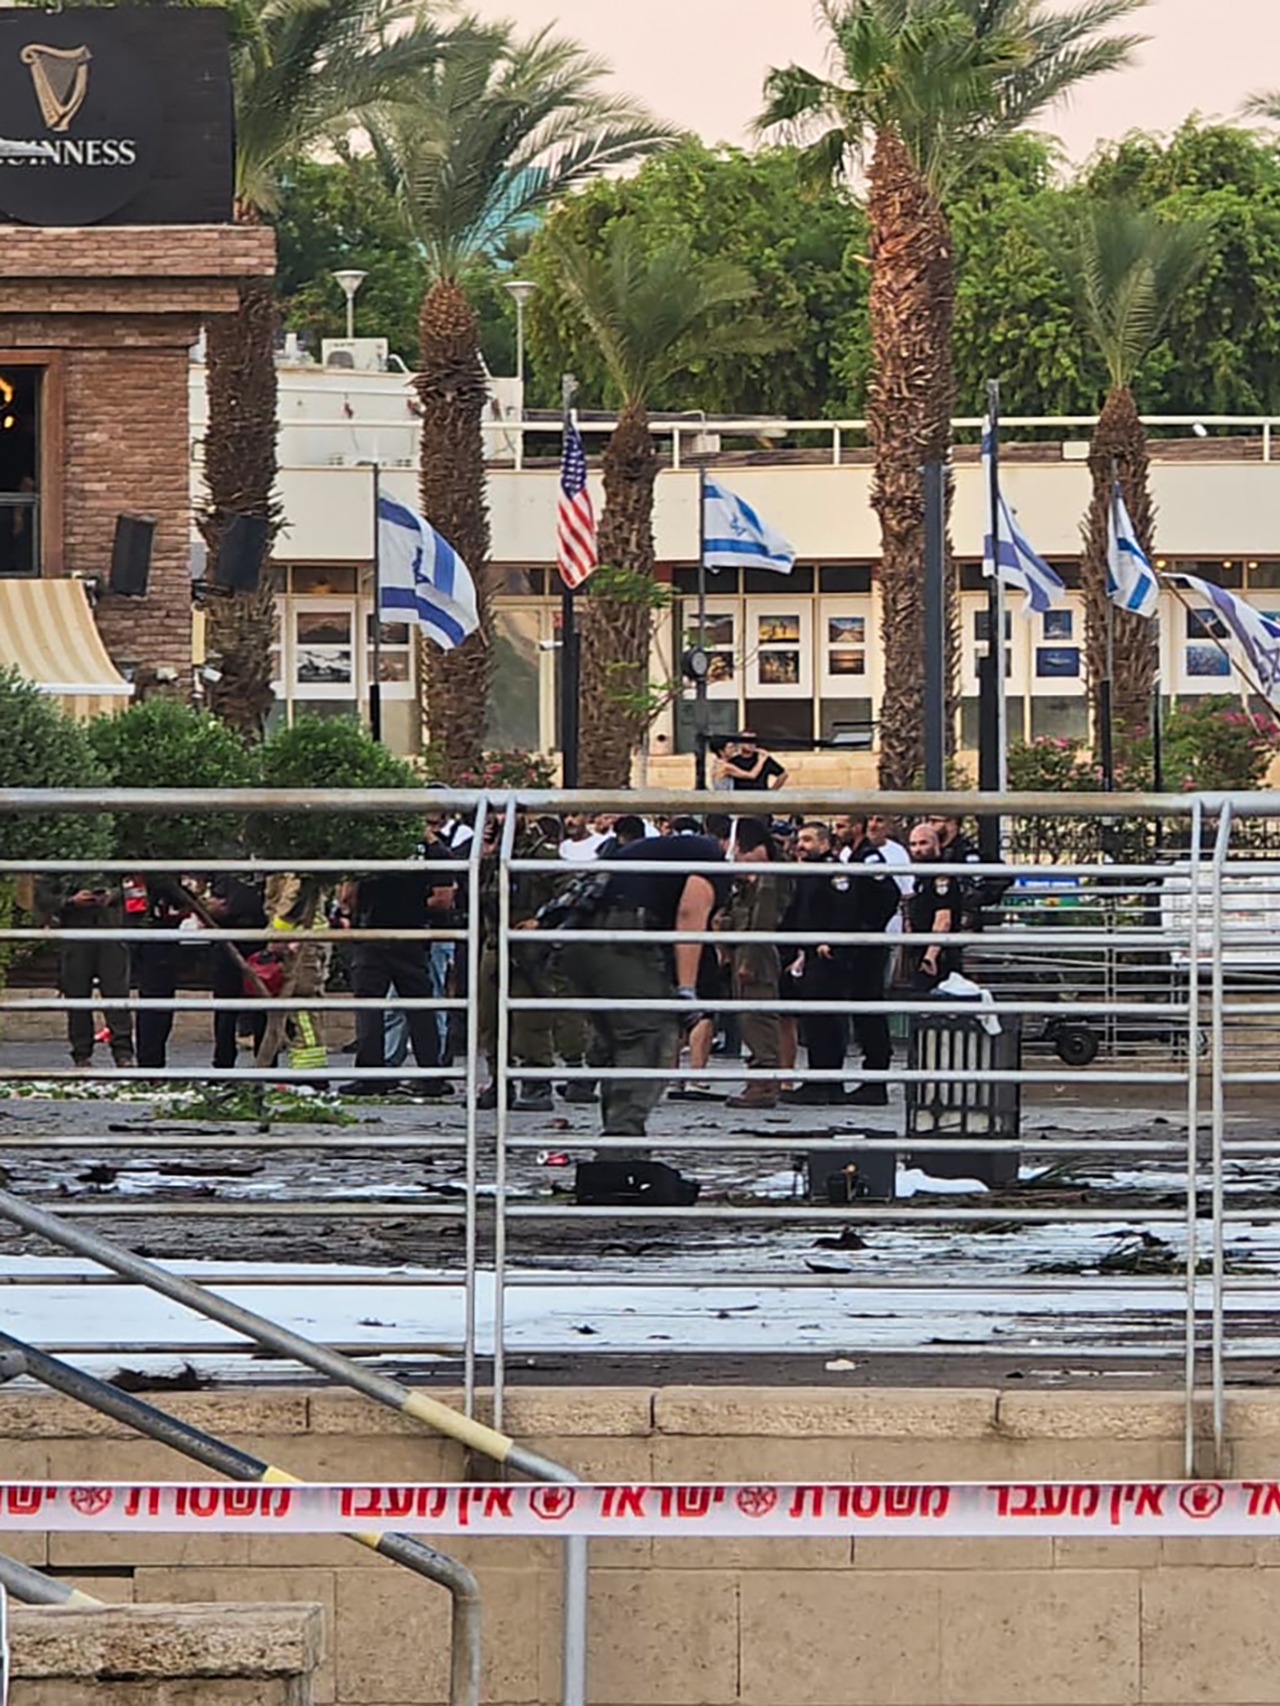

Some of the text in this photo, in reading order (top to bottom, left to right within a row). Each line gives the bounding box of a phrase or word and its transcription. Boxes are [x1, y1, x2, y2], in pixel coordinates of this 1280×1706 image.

[457, 1486, 514, 1526] אין
[788, 1485, 951, 1518] משטרת
[987, 1484, 1099, 1517] מעבר
[1110, 1483, 1164, 1525] אין
